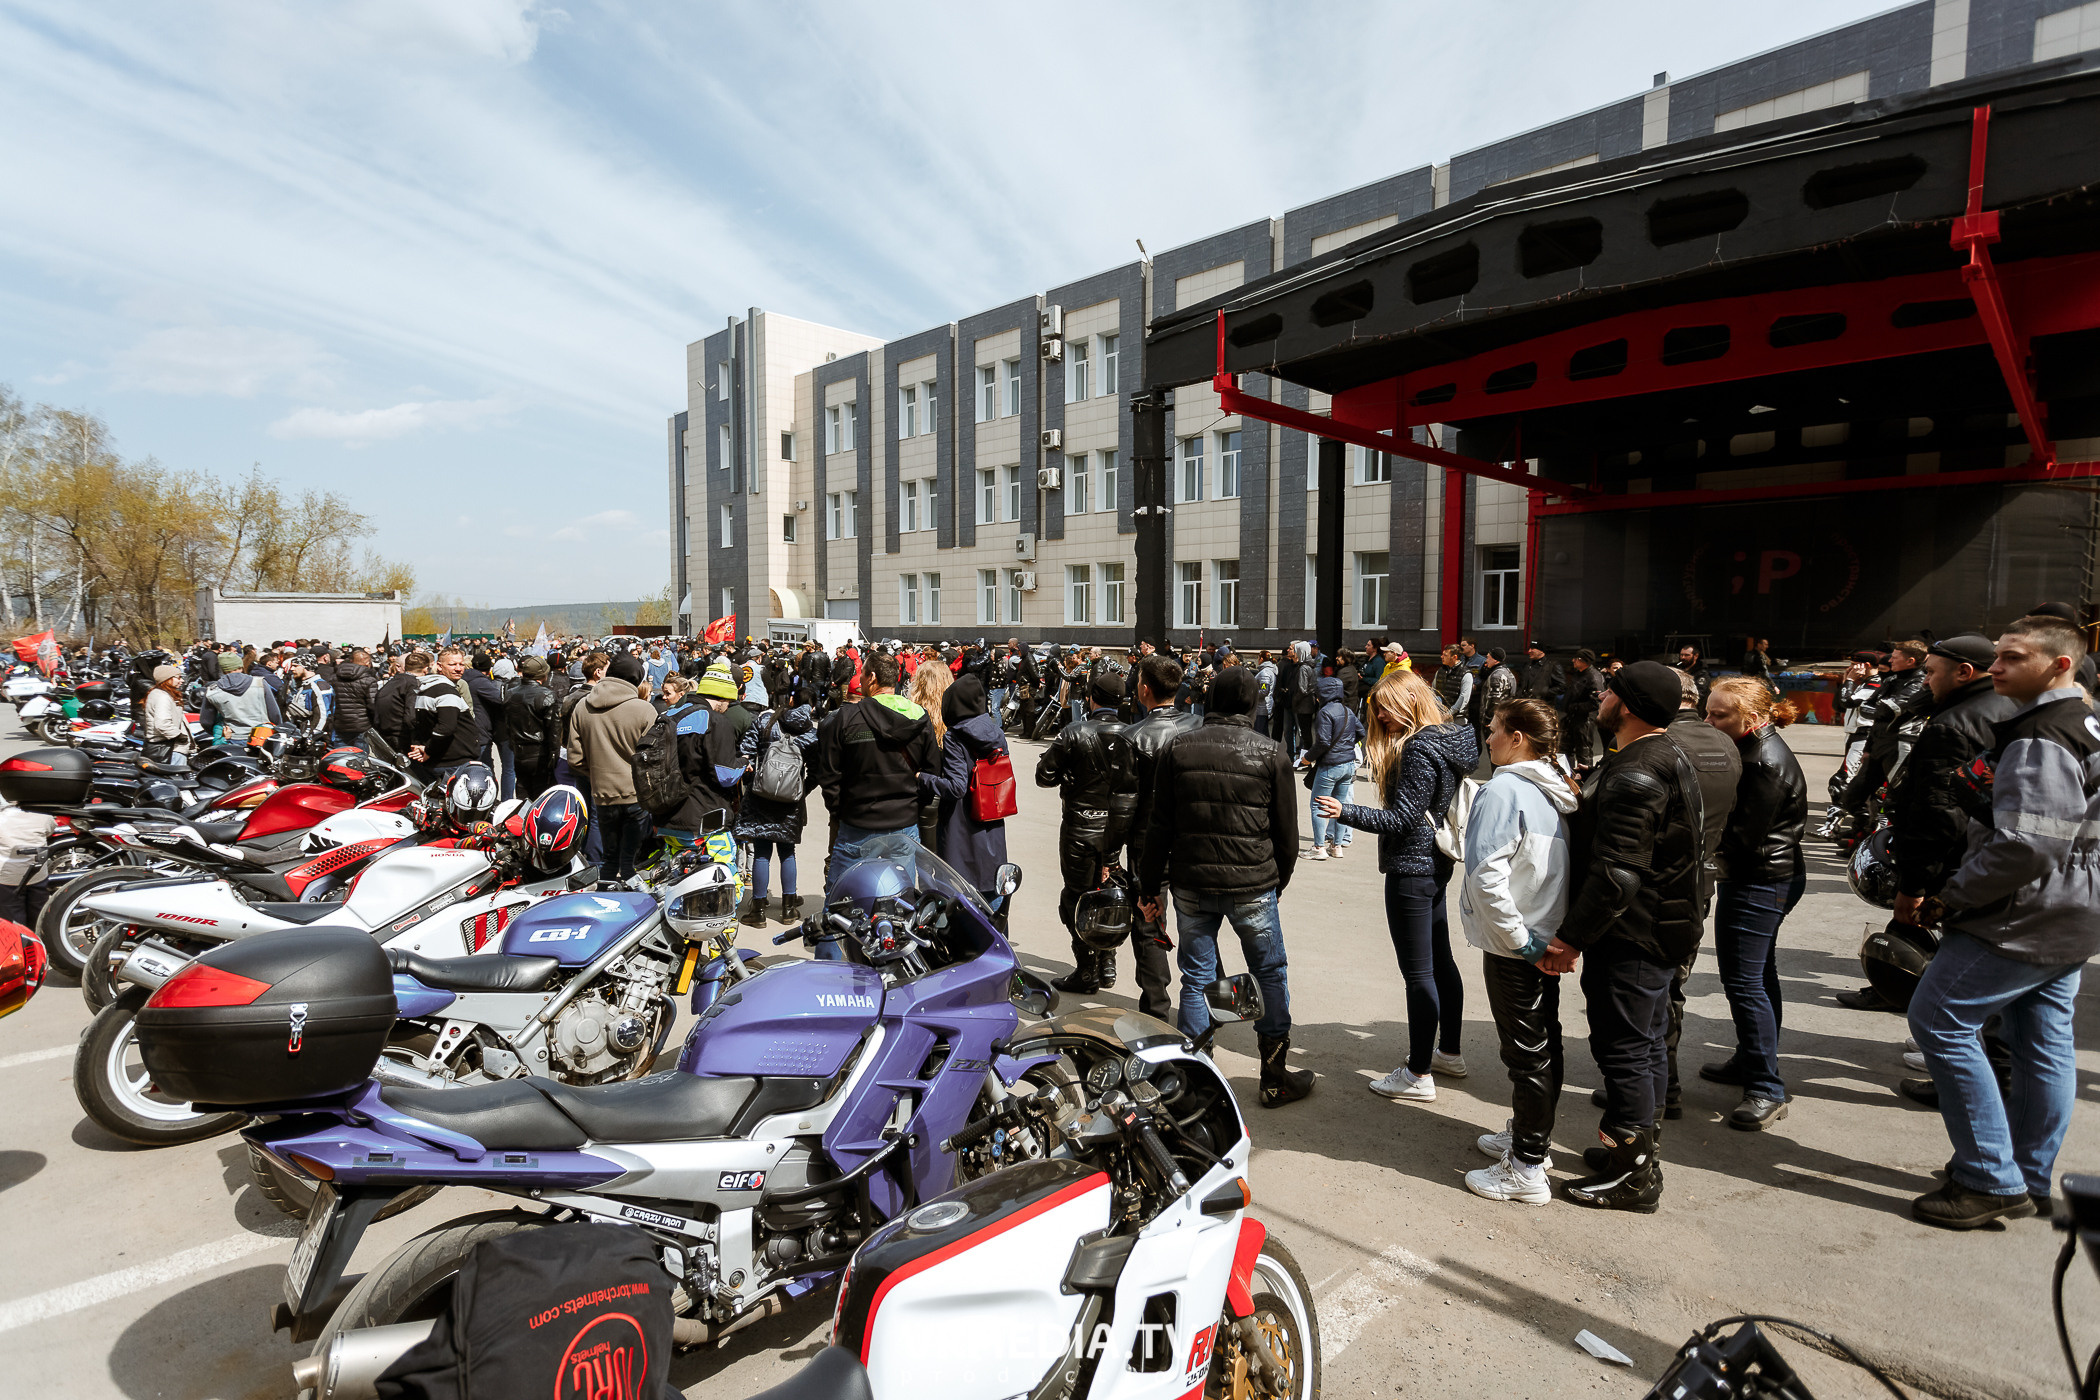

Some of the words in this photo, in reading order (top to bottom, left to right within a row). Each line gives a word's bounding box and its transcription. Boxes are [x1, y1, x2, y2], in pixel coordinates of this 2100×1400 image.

[155, 912, 219, 927] 1000R
[528, 924, 592, 943] CB-1
[815, 994, 875, 1009] YAMAHA
[719, 1173, 750, 1188] elf
[633, 1208, 662, 1223] CRAZY
[661, 1216, 682, 1228] IRON
[528, 1282, 651, 1331] www.torchelmets.com
[570, 1340, 611, 1365] helmets
